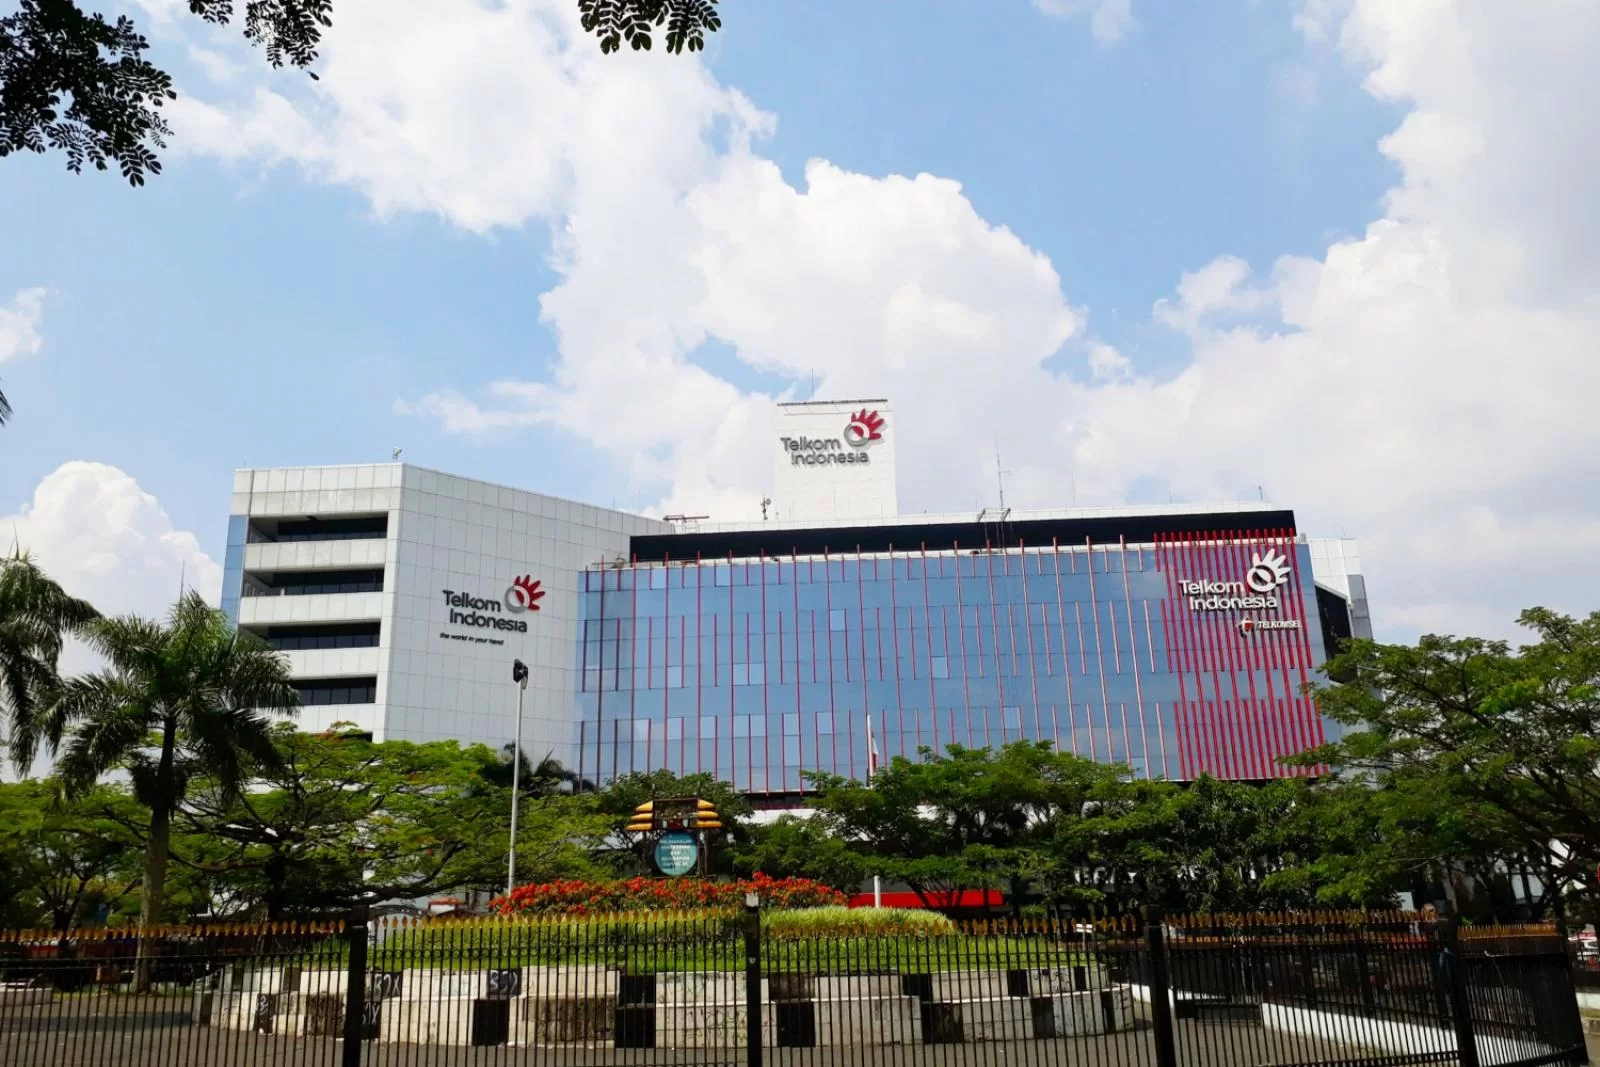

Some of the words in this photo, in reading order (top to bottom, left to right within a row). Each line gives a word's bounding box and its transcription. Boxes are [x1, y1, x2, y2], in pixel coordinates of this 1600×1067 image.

[780, 436, 842, 452] Telkom
[791, 451, 869, 465] Indonesia
[1178, 579, 1244, 595] Telkom
[442, 589, 502, 612] Telkom
[1190, 595, 1278, 611] Indonesia
[449, 608, 528, 633] Indonesia
